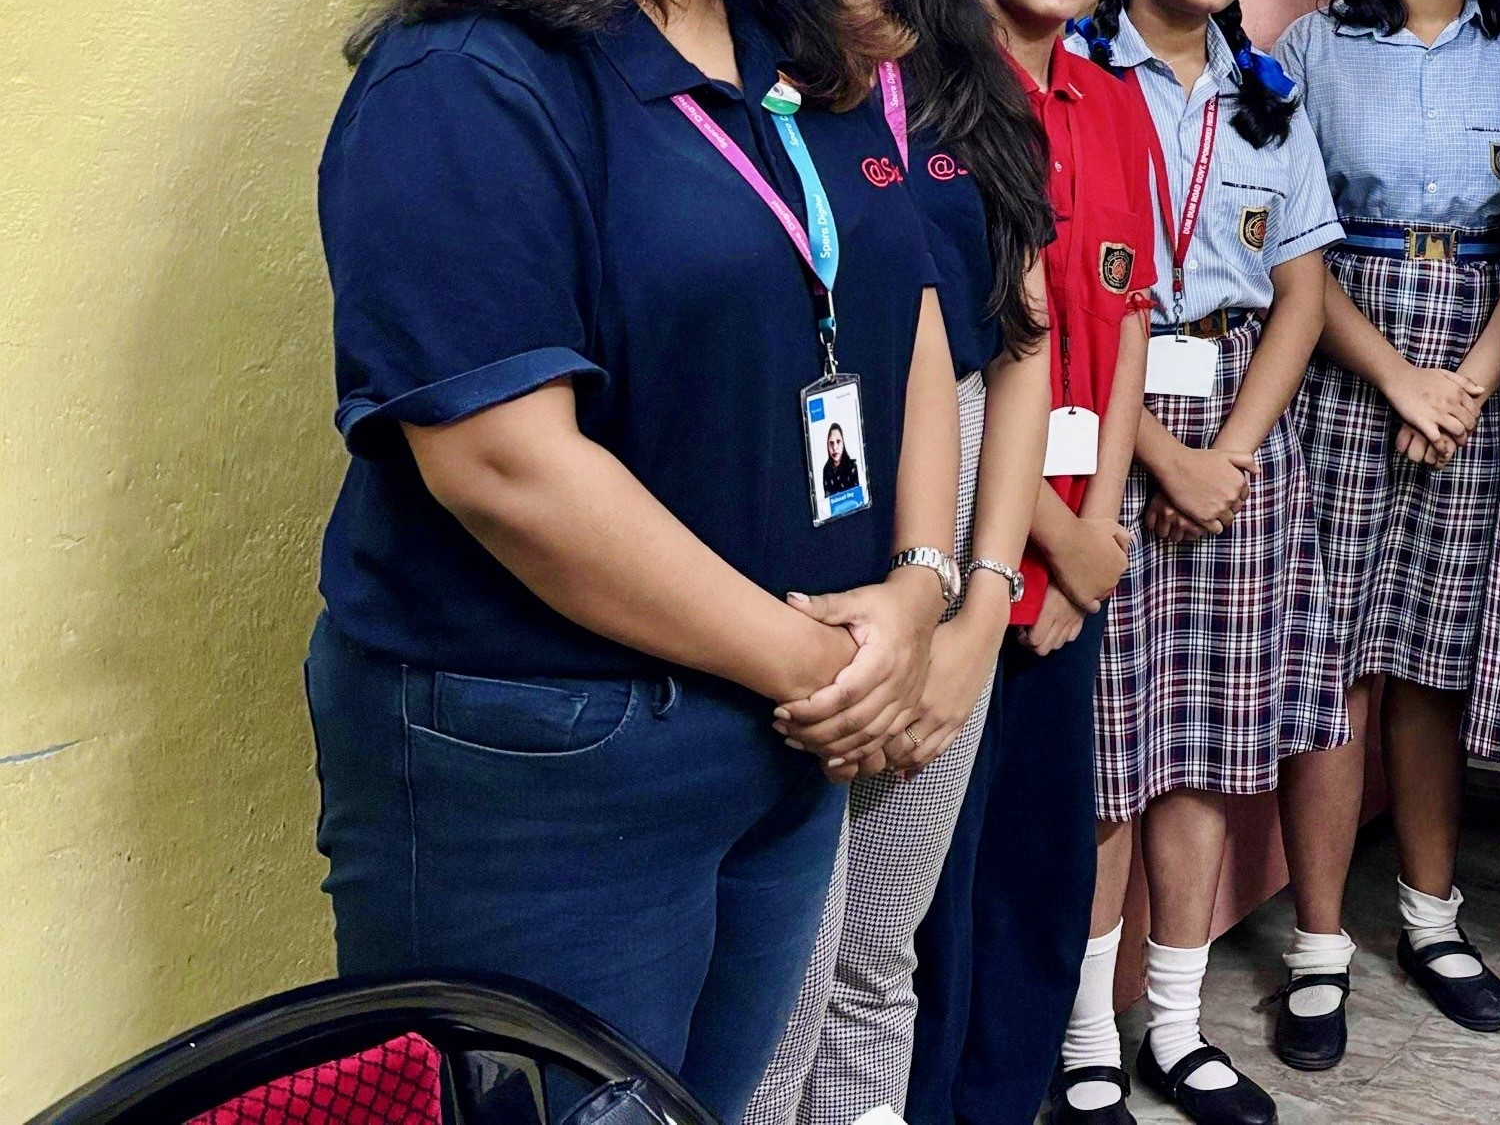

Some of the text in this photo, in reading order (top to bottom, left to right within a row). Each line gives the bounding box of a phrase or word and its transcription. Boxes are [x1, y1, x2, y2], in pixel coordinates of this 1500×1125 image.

[890, 85, 899, 108] Spera
[703, 123, 729, 149] Spera
[1183, 110, 1215, 235] DUM DUM ROAD GOVT. SPONSORED HIGH
[770, 200, 797, 231] Digital
[813, 193, 832, 259] Spera Digital
